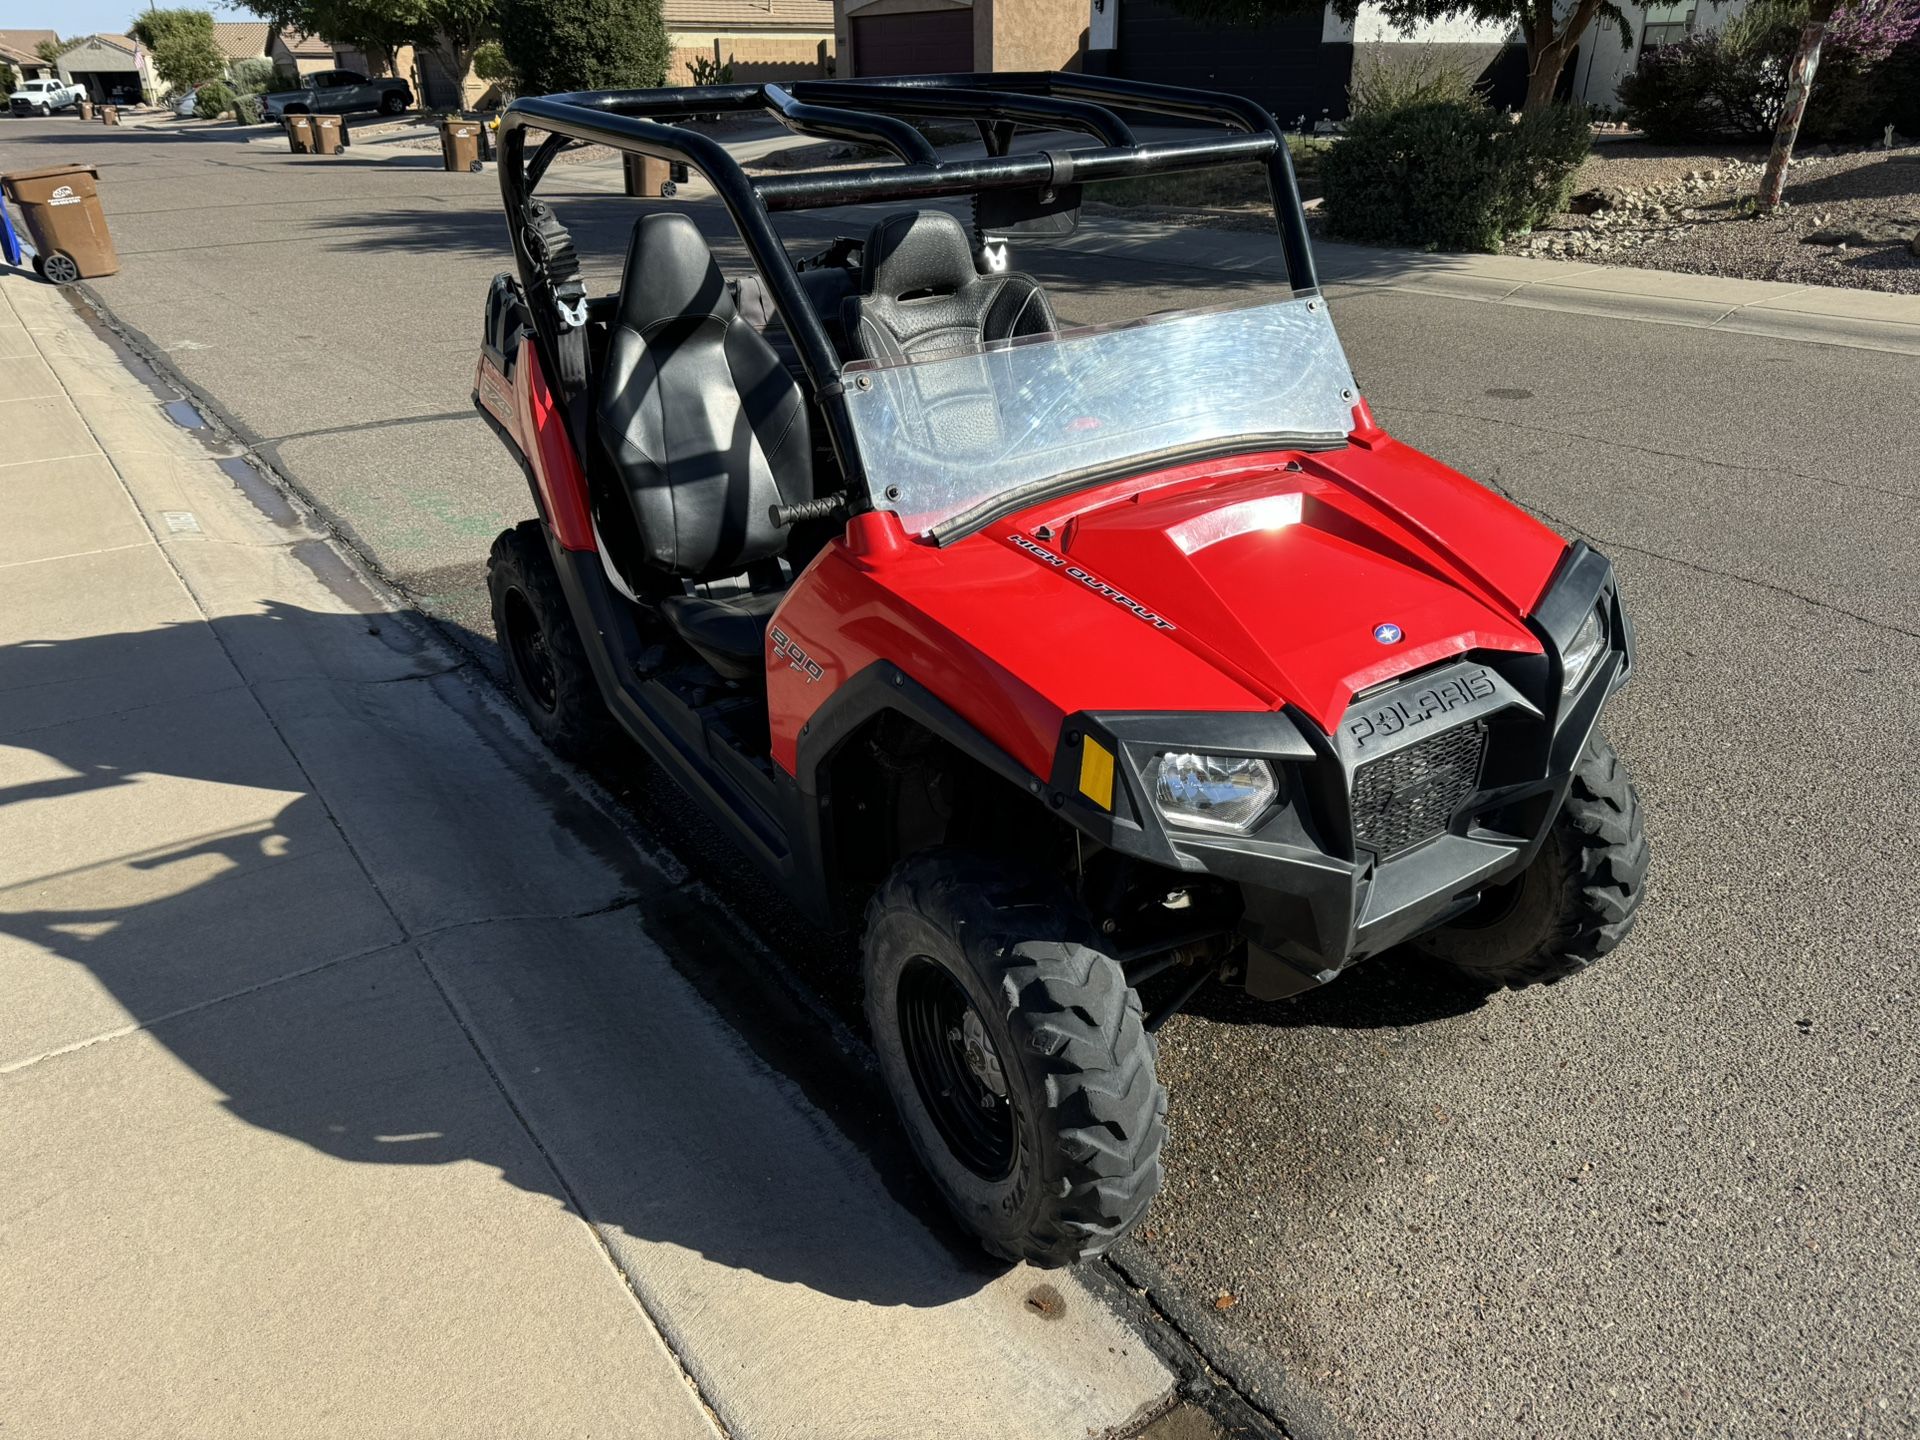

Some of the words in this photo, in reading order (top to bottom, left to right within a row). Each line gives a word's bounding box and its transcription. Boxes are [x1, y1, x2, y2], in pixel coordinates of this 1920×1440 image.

[1007, 534, 1067, 567] HIGH
[1065, 567, 1177, 631] OUTPUT
[769, 625, 824, 681] 800
[773, 645, 812, 684] EFI
[1344, 669, 1497, 749] POLARIS
